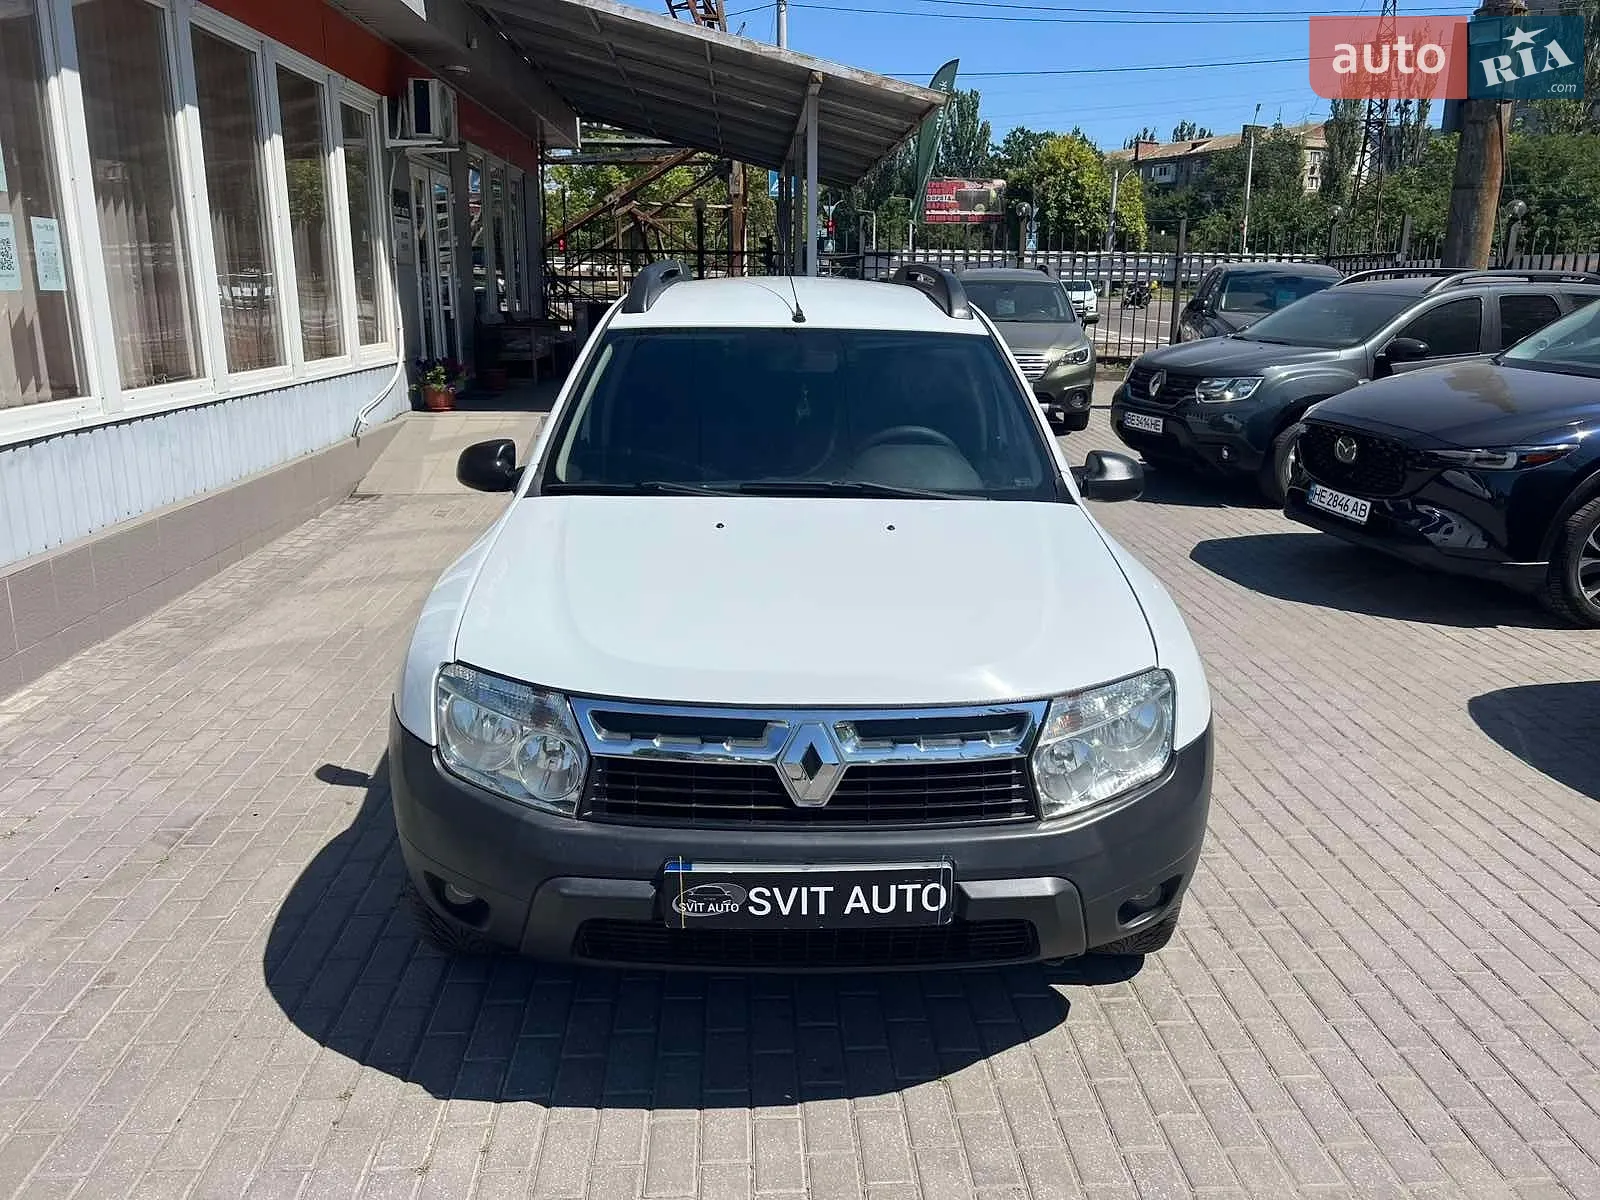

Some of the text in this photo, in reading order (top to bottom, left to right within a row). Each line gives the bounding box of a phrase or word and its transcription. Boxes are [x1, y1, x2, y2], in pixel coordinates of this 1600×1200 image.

[1327, 492, 1350, 512] 2846
[678, 902, 739, 913] SVIT AUTO
[748, 882, 947, 916] SVIT AUTO
